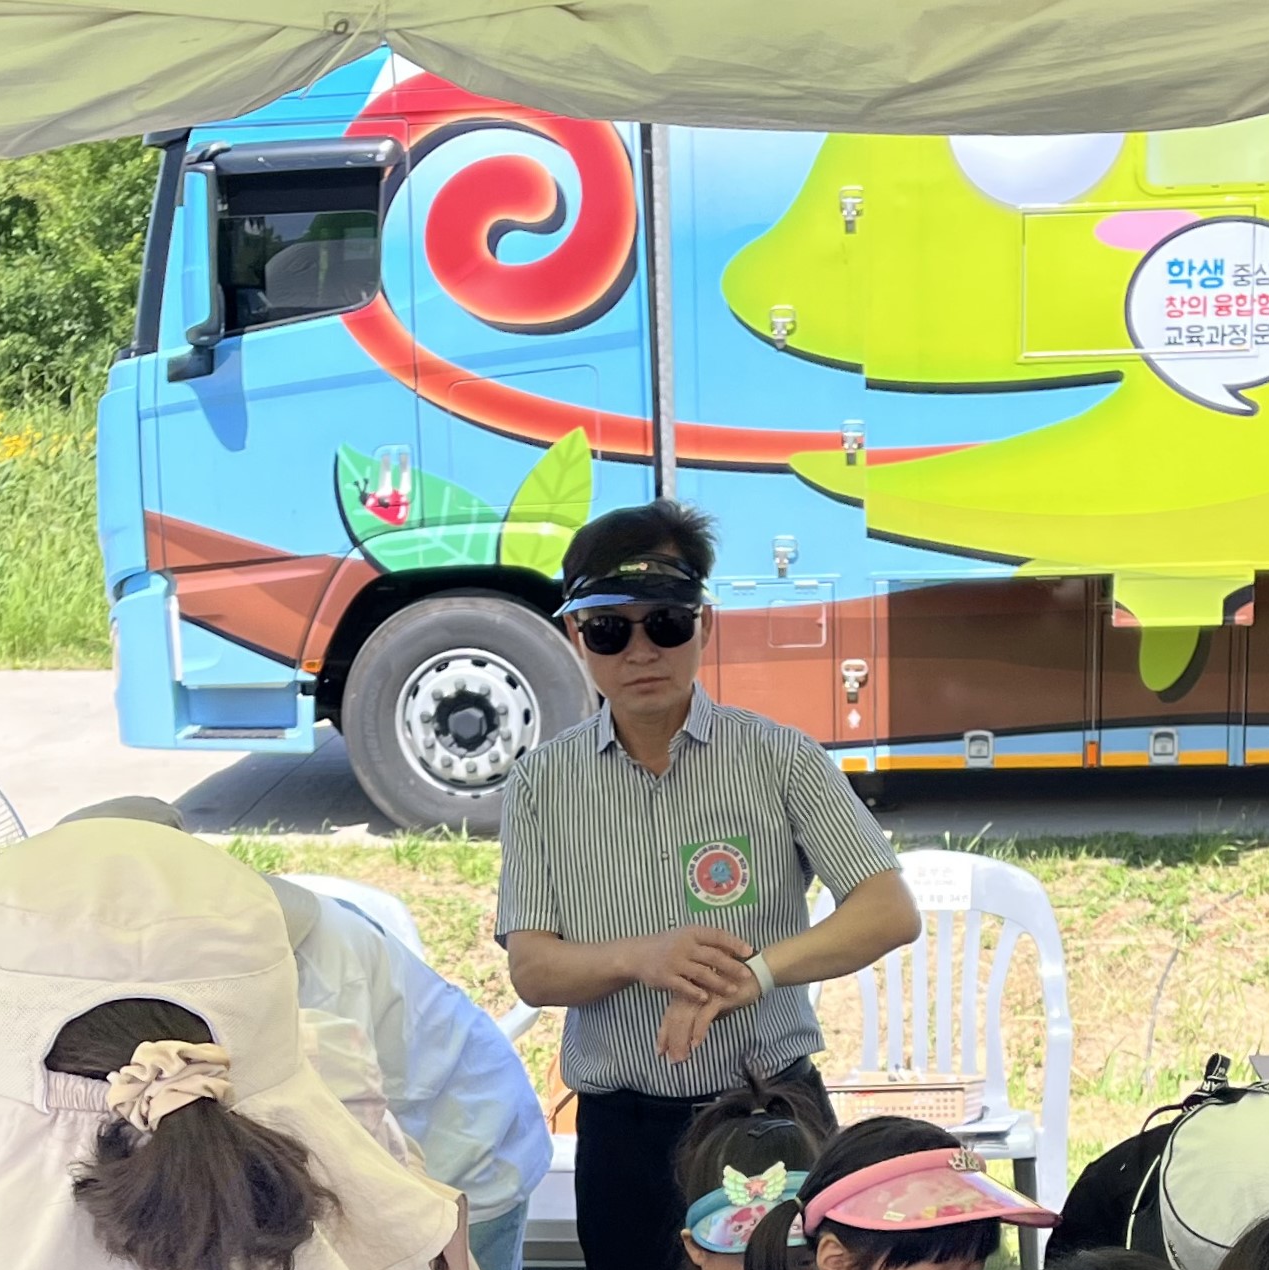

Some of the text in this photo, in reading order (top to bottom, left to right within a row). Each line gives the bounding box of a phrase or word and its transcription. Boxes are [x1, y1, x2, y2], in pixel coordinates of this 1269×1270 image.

[1166, 258, 1225, 289] 학생
[1166, 296, 1207, 318] 창의
[1164, 322, 1248, 347] 교육과정
